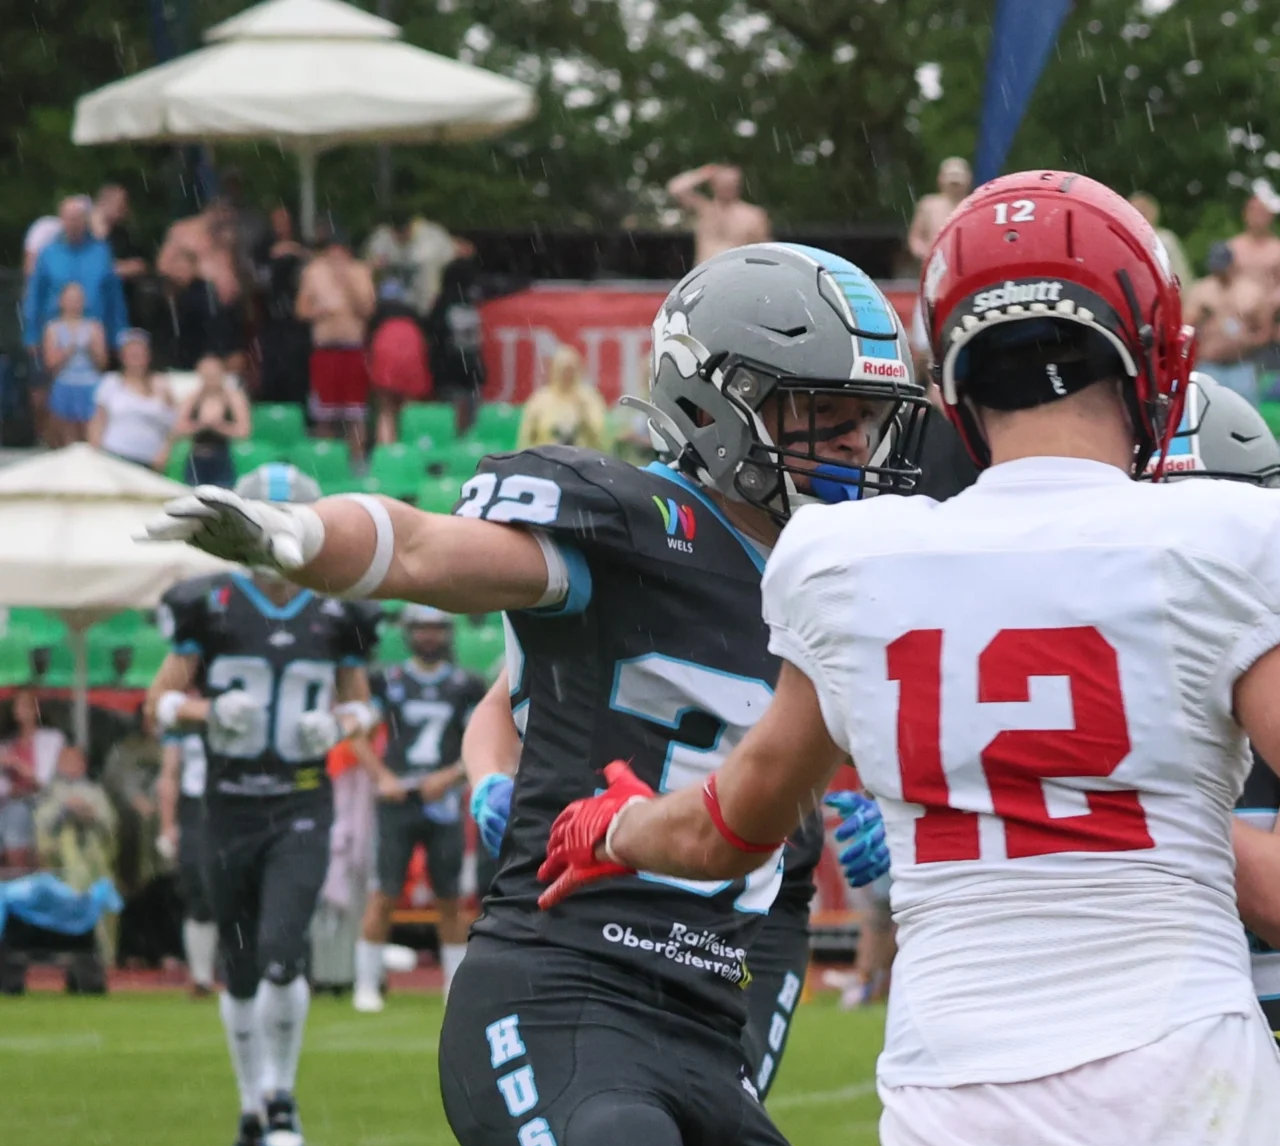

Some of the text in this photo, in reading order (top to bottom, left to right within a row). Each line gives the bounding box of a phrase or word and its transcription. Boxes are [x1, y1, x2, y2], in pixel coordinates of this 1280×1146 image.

[993, 200, 1036, 225] 12
[973, 281, 1063, 313] schutt
[863, 361, 906, 378] Riddell
[667, 537, 694, 554] WELS
[402, 699, 454, 767] 7
[885, 625, 1157, 865] 12
[602, 922, 742, 985] Oberösterreich
